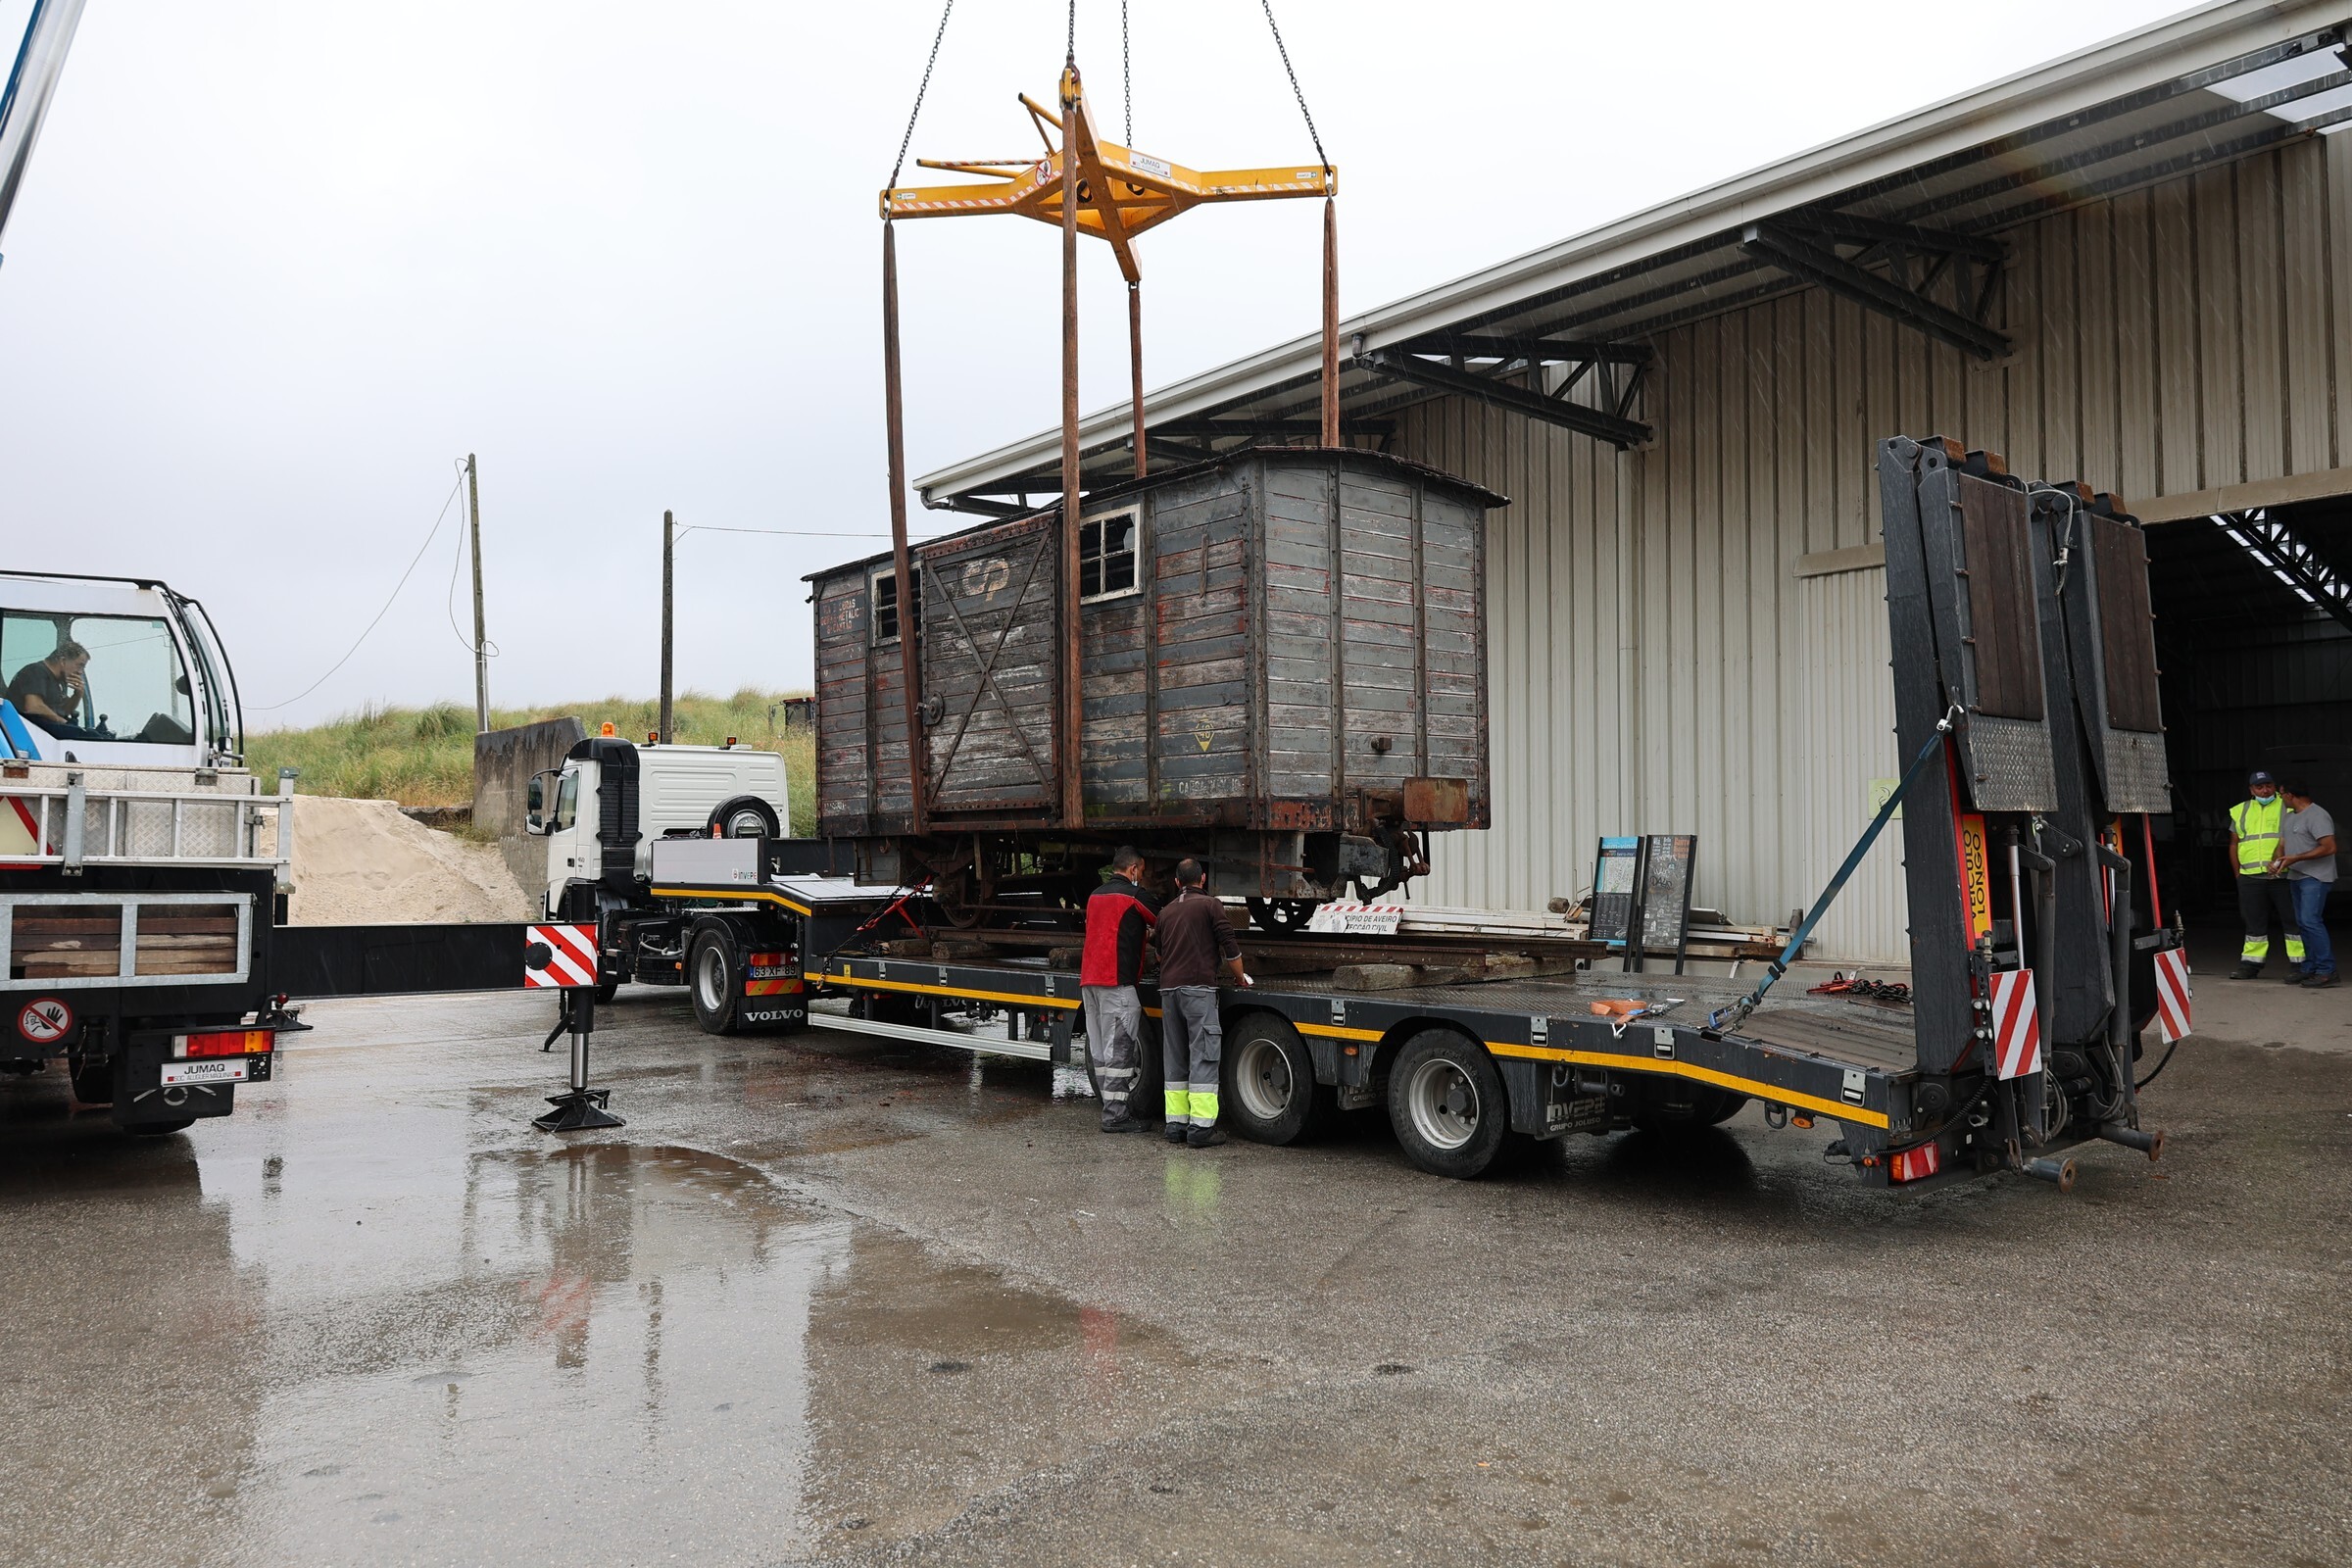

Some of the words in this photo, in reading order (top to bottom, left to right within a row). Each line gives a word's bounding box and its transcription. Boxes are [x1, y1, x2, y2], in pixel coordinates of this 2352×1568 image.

[1973, 833, 1985, 914] LONGO
[745, 1008, 804, 1022] VOLVO
[184, 1063, 225, 1075] JUMAQ
[1549, 1122, 1573, 1132] GRUPO
[1574, 1117, 1601, 1127] JOLUSO
